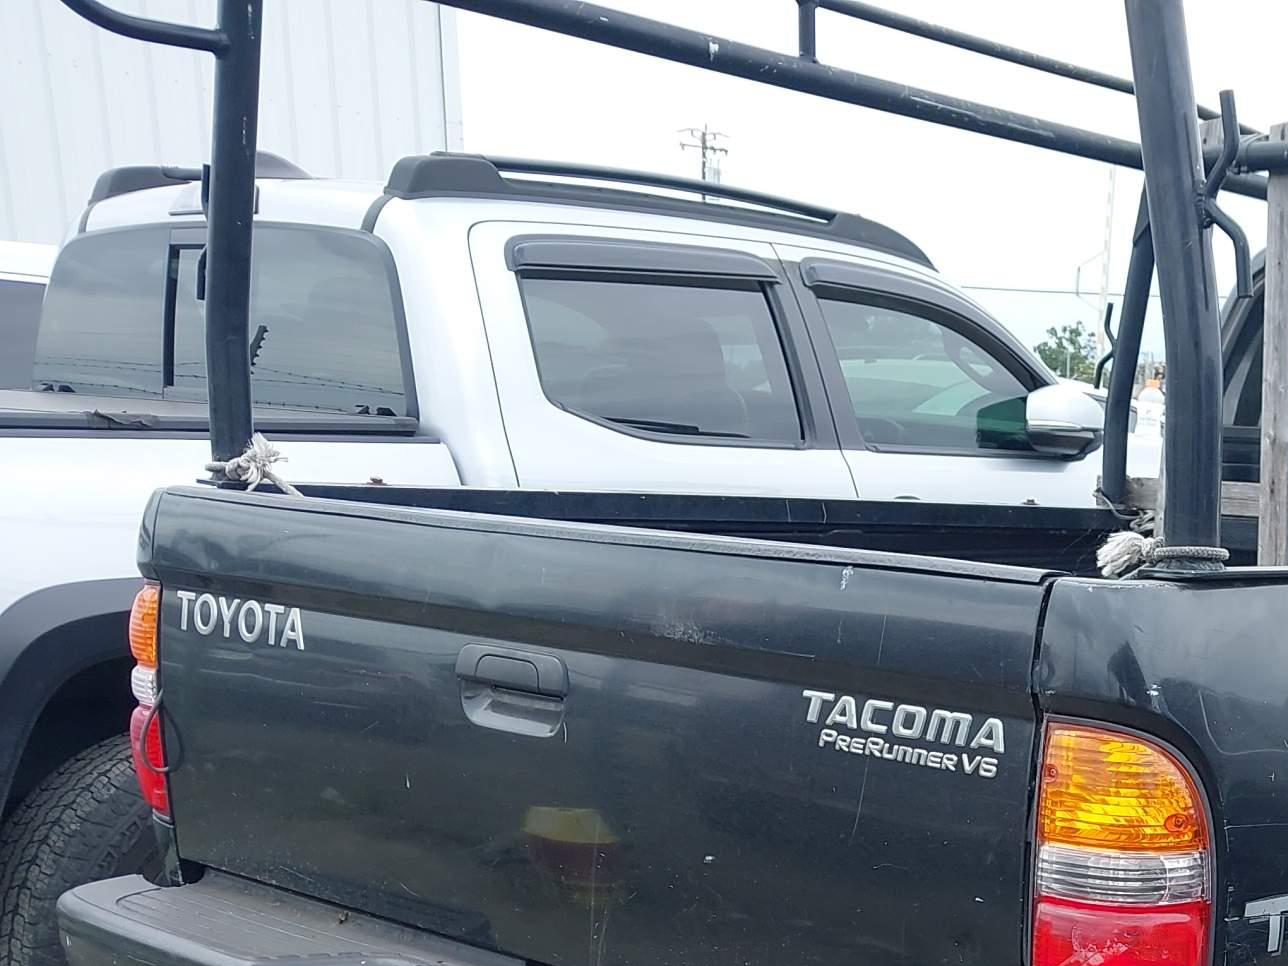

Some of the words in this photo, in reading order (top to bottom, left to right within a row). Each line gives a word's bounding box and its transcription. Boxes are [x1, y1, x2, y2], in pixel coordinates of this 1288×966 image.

[177, 590, 305, 650] TOYOTA
[802, 689, 1005, 753] TACOMA
[961, 752, 998, 778] V6
